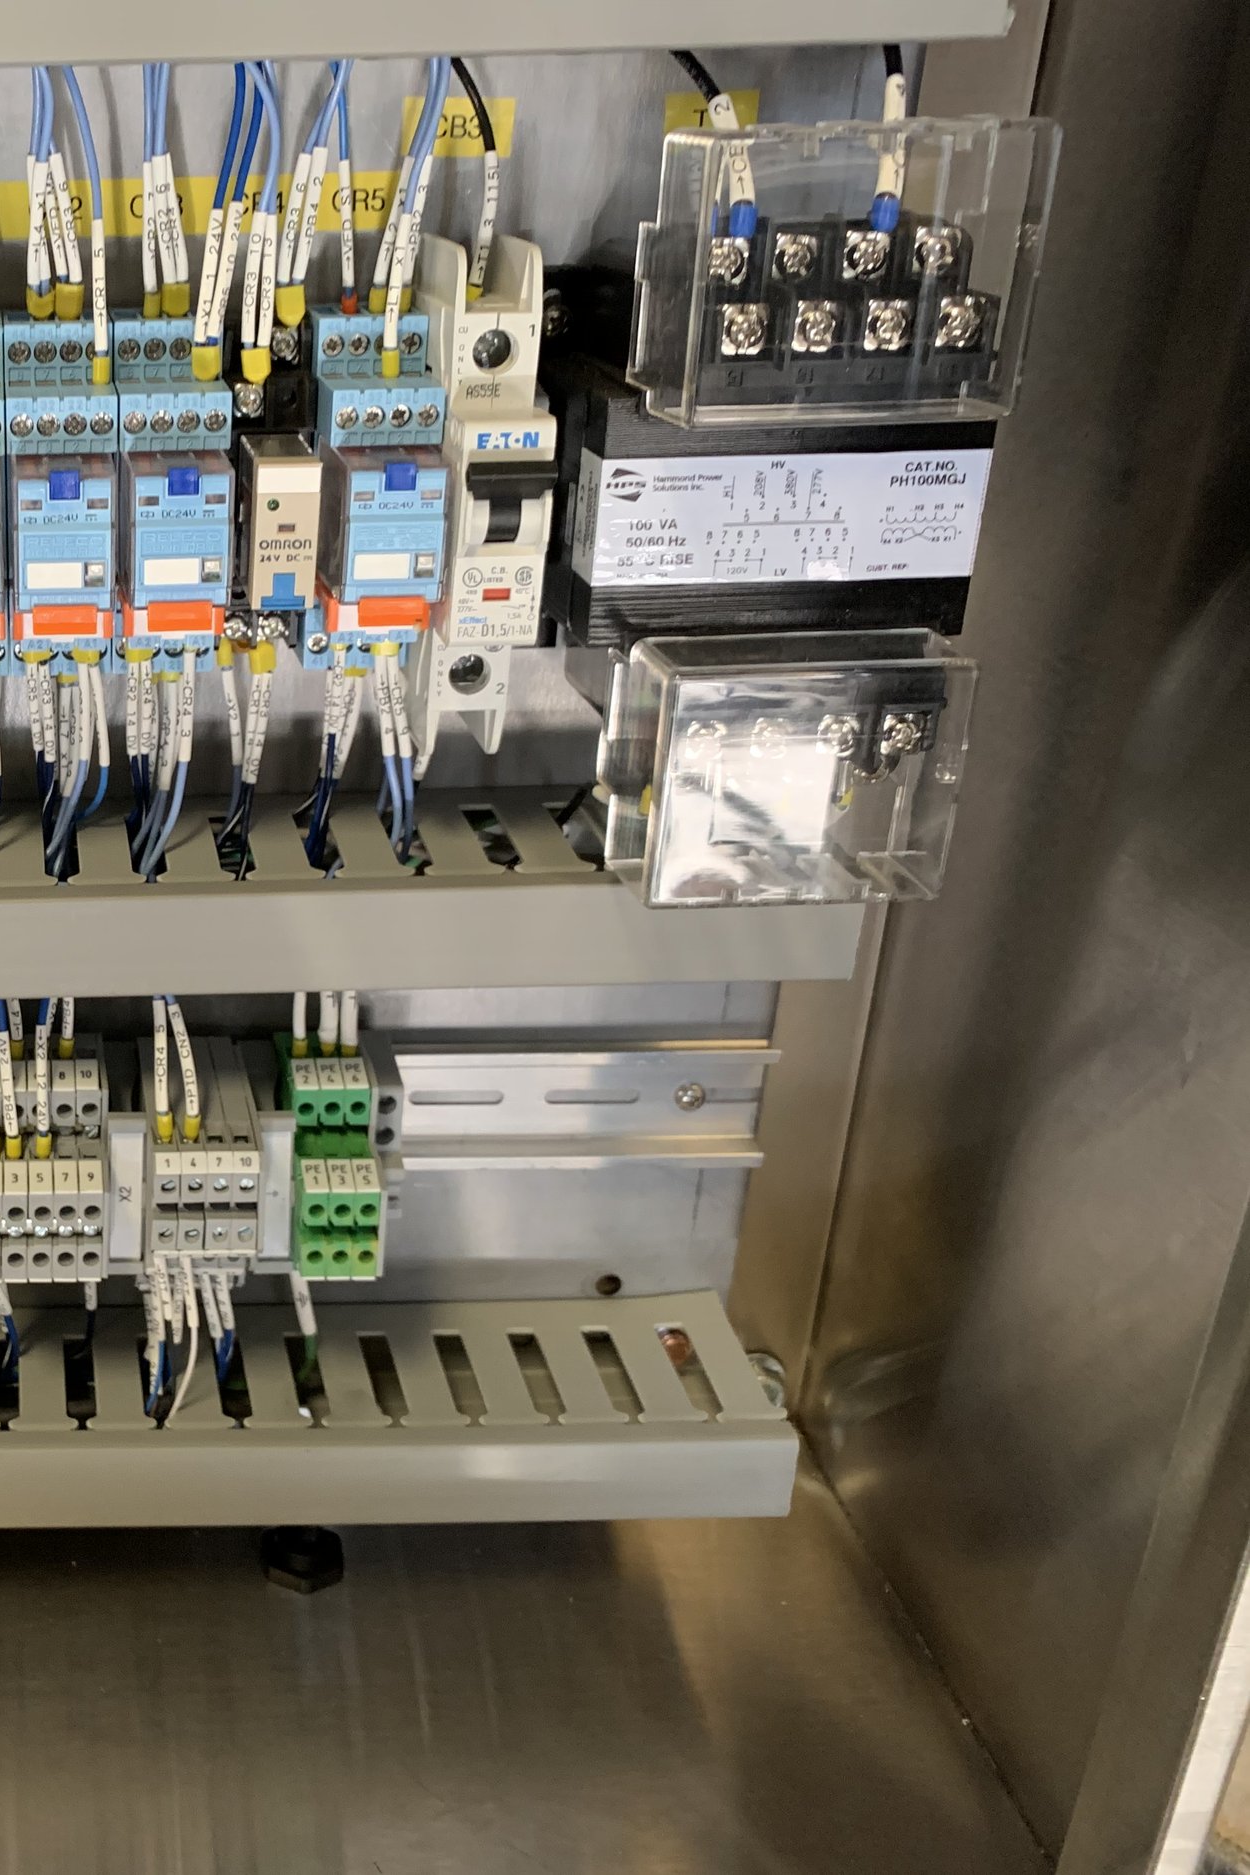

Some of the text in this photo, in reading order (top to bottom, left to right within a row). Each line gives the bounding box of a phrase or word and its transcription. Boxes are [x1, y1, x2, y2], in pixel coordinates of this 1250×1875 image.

[529, 324, 536, 337] 1
[771, 460, 786, 469] HV
[653, 474, 695, 482] Hammond
[653, 484, 689, 492] Solutions
[659, 519, 678, 530] VA
[668, 536, 687, 547] Hz
[774, 568, 788, 576] LV
[495, 683, 505, 695] 2
[0, 1039, 9, 1065] 24V
[37, 1042, 46, 1060] X2
[155, 1024, 167, 1077] CR4 5
[172, 1011, 197, 1098] PID CN2 3
[295, 1065, 311, 1074] PE
[320, 1064, 336, 1073] PE
[345, 1064, 361, 1073] PE
[58, 1070, 66, 1080] 8
[80, 1069, 92, 1079] 10
[165, 1158, 170, 1167] 1
[190, 1157, 197, 1167] 4
[215, 1157, 222, 1167] 7
[240, 1157, 252, 1167] 10
[305, 1164, 321, 1174] PE
[331, 1164, 347, 1174] PE
[357, 1164, 373, 1173] PE
[11, 1173, 19, 1183] 3
[36, 1173, 44, 1183] 5
[62, 1172, 69, 1182] 7
[87, 1172, 94, 1181] 9
[119, 1185, 132, 1202] X2
